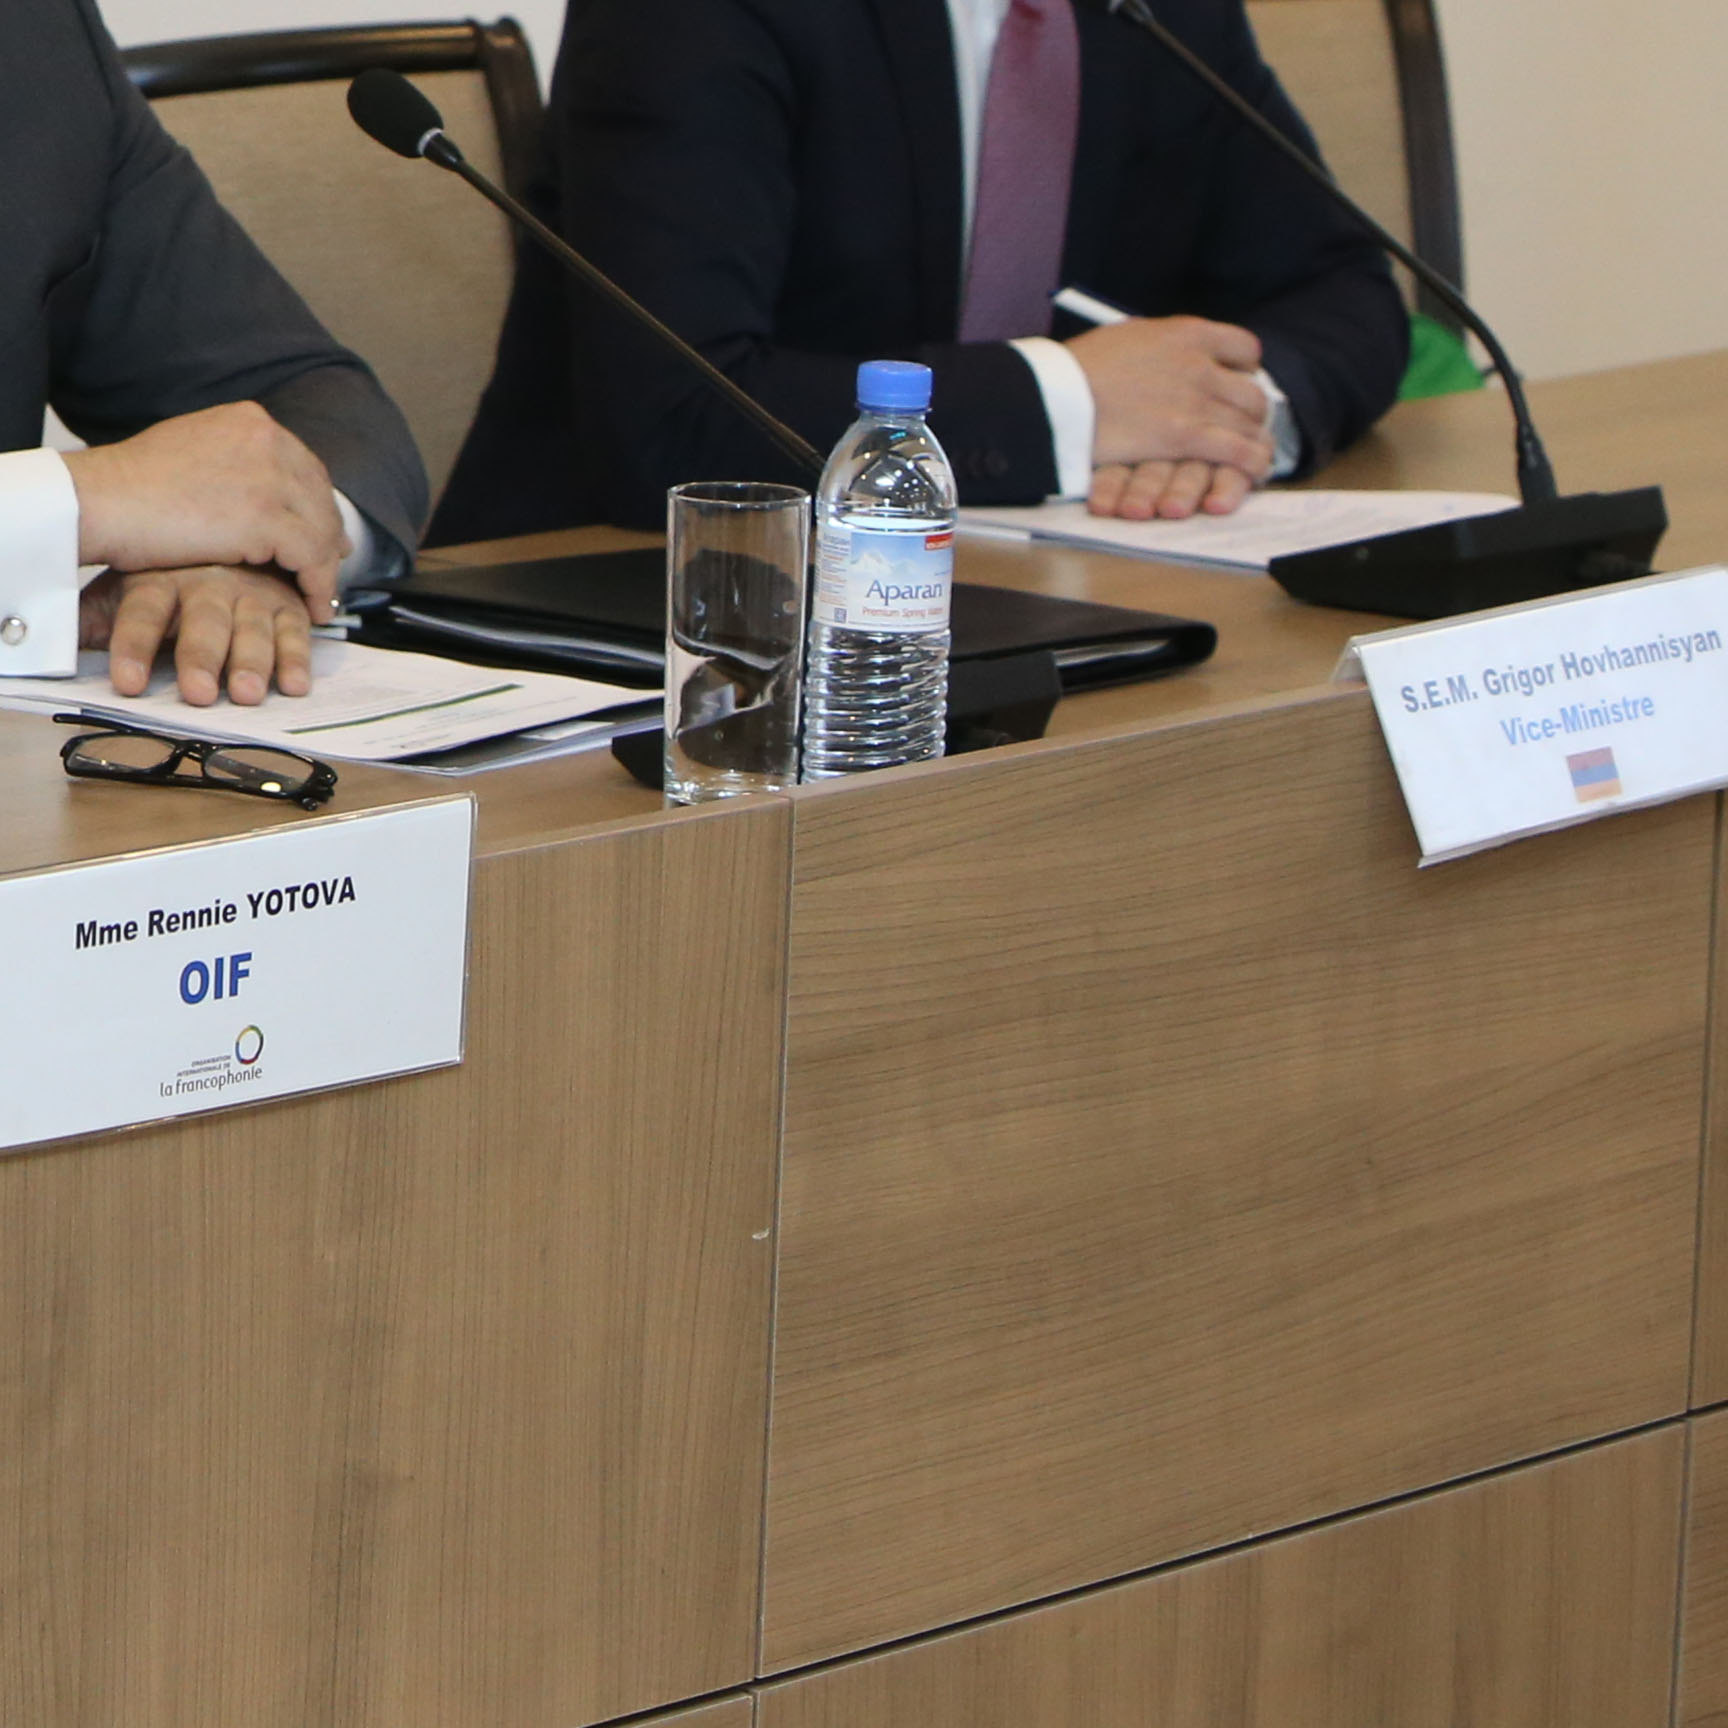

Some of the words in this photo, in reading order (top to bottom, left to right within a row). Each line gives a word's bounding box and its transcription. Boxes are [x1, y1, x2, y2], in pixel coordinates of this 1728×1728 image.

[865, 579, 944, 607] Aparan
[1400, 674, 1479, 713] S.E.M.
[1482, 663, 1556, 697] Grigor
[1559, 629, 1723, 681] Hovhannisyan
[1499, 695, 1656, 746] Vice-Ministre
[75, 920, 139, 950] Mme
[148, 898, 238, 938] Rennie
[246, 876, 356, 920] YOTOVA
[179, 951, 253, 1005] OIF
[159, 1082, 173, 1098] la
[175, 1066, 263, 1095] francophonie
